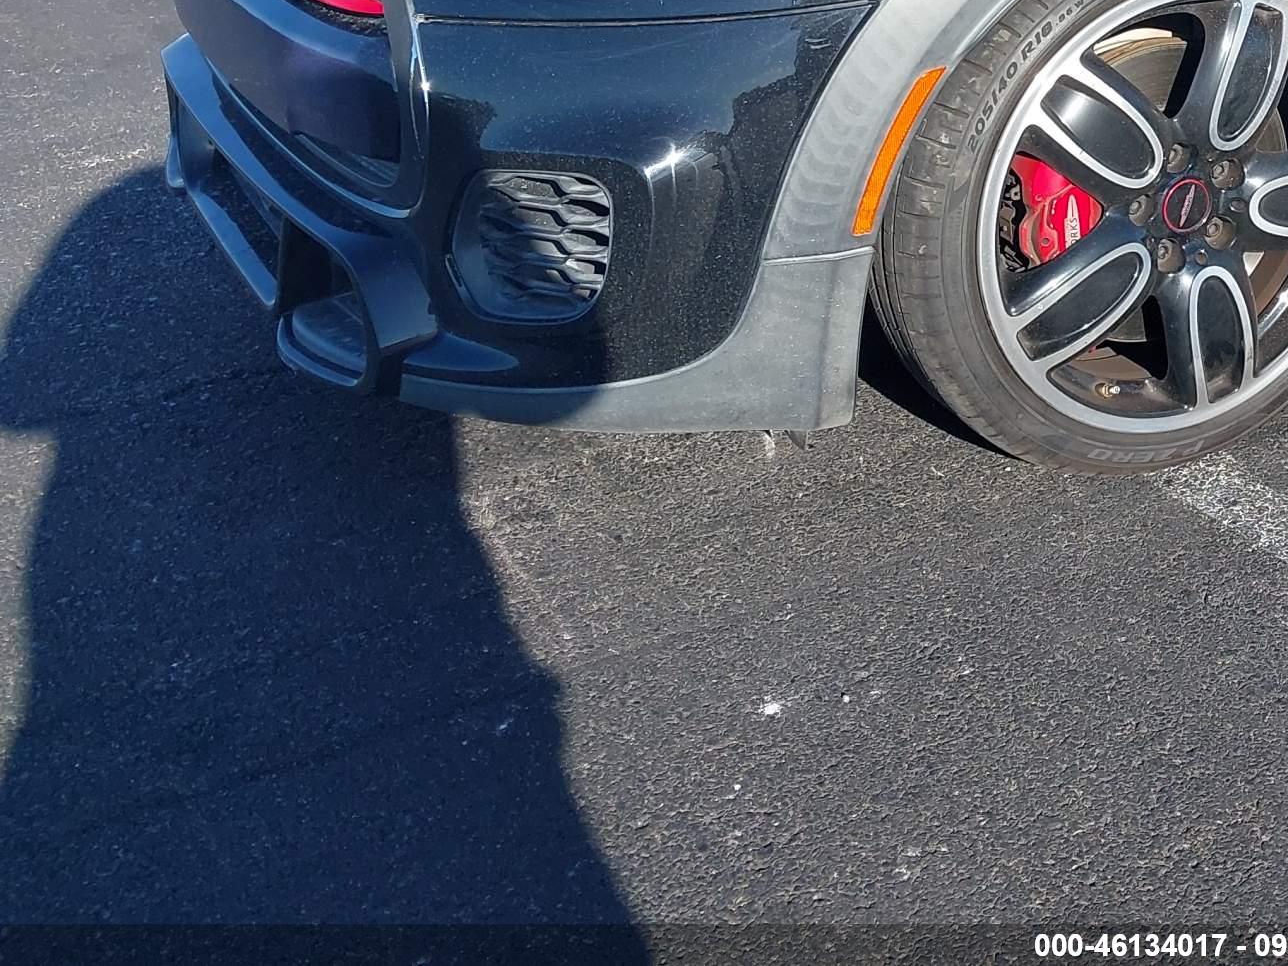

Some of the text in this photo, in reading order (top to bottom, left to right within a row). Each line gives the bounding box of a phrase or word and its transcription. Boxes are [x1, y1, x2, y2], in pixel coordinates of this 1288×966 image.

[967, 61, 1018, 154] 205/40
[1020, 20, 1053, 62] R18
[1087, 440, 1205, 463] P ZERO
